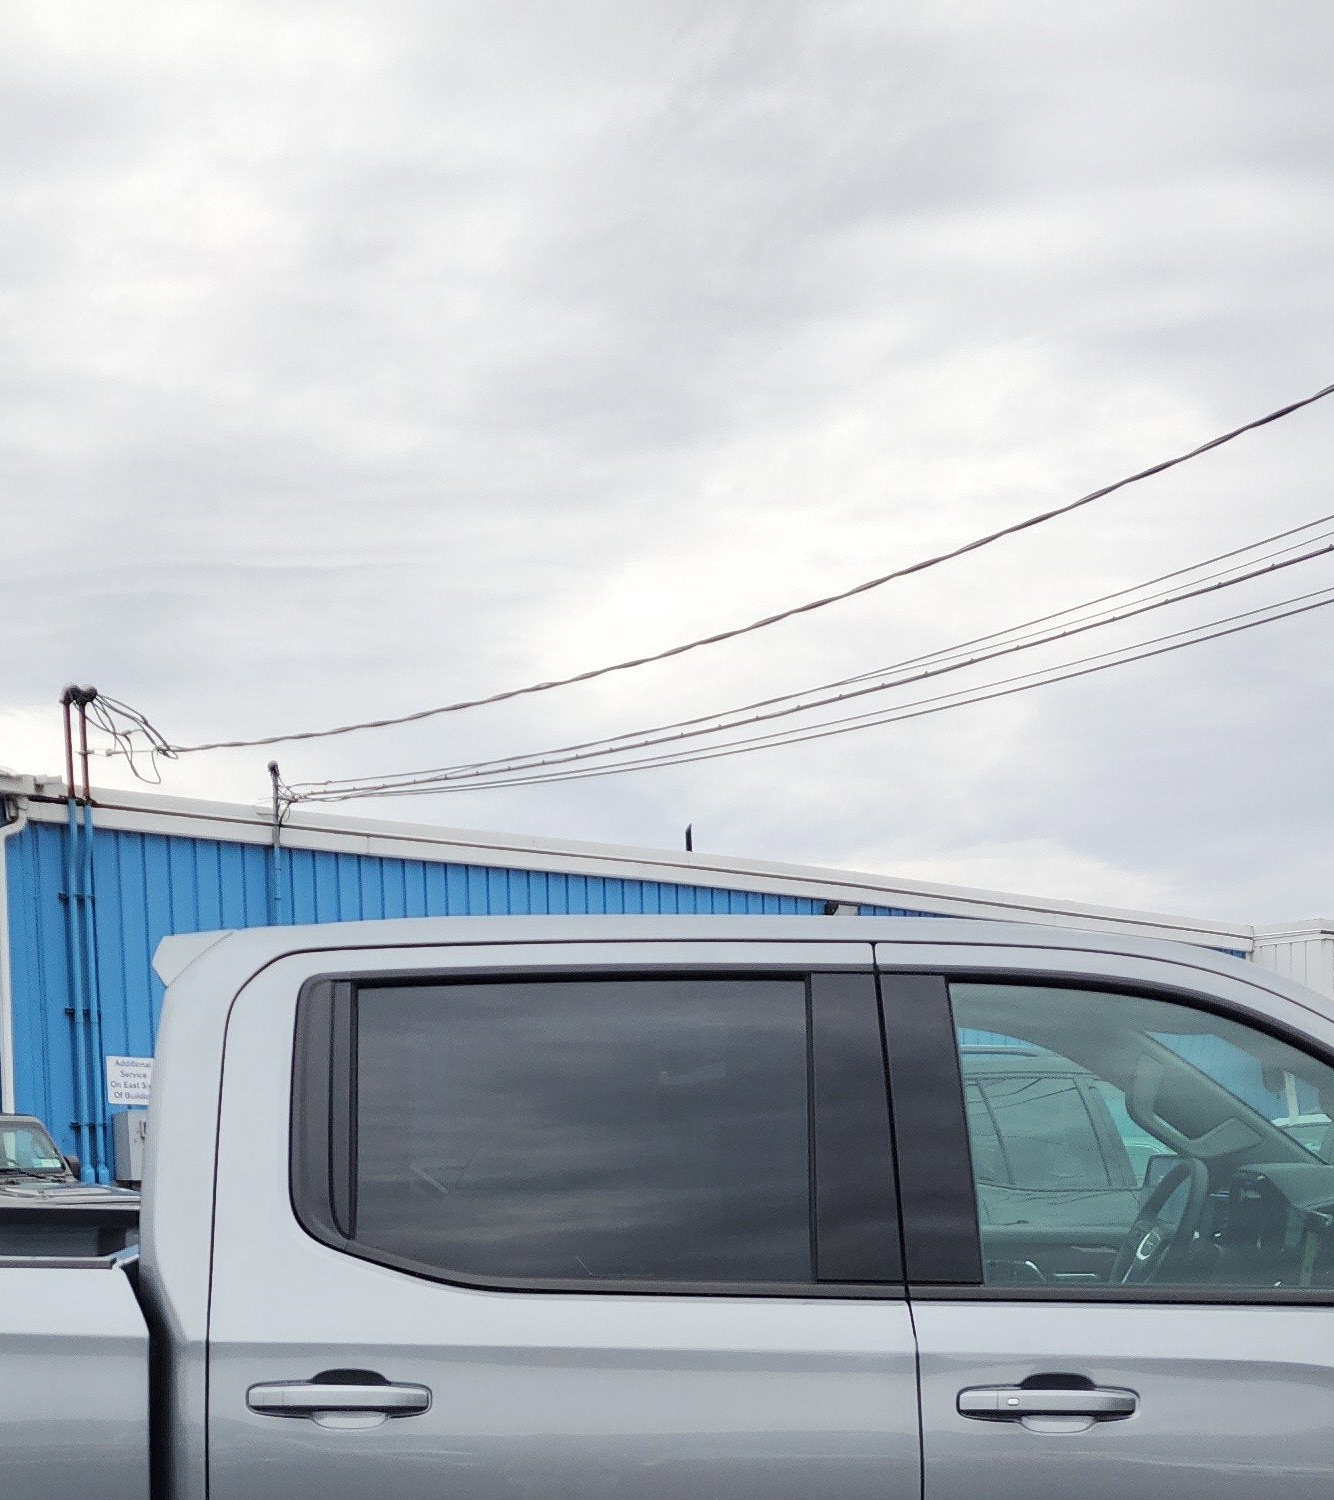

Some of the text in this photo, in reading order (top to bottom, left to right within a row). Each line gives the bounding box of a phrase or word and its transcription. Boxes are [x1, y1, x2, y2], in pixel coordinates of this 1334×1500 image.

[120, 1070, 147, 1078] Service
[110, 1080, 121, 1088] On
[123, 1081, 140, 1089] East
